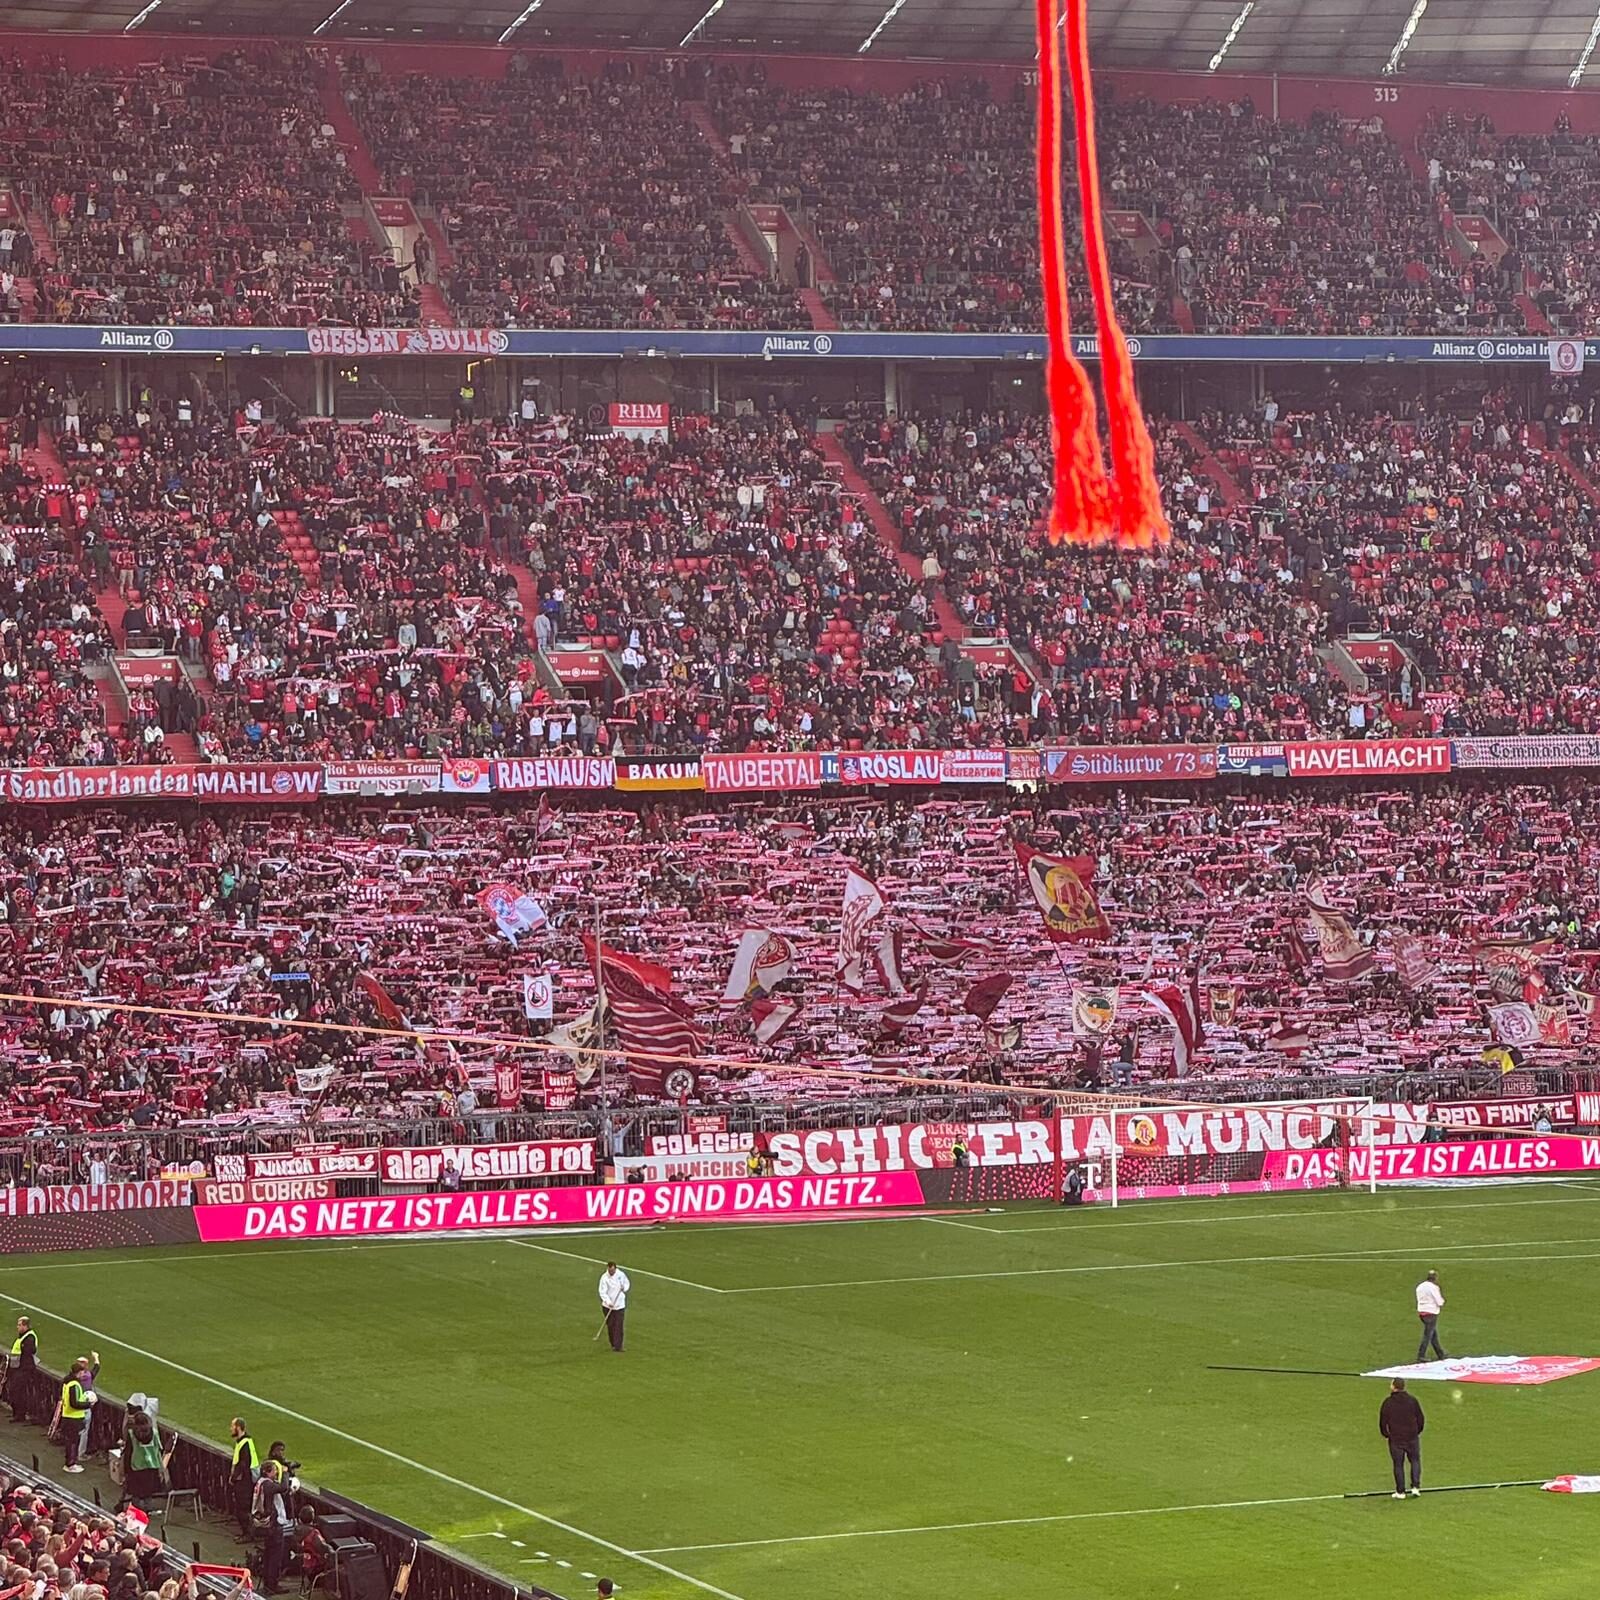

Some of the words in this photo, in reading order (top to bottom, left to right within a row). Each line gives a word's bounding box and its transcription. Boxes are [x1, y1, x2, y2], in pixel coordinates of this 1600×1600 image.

[1374, 87, 1399, 102] 313
[101, 332, 152, 346] Allianz
[307, 328, 399, 354] GIESSEN
[428, 329, 501, 355] BULLS
[763, 337, 811, 351] Allianz
[1432, 343, 1476, 356] Allianz
[1496, 343, 1536, 356] Global
[618, 403, 663, 419] RHM
[1227, 745, 1254, 757] LETZTE
[1262, 744, 1284, 756] REIHE
[1289, 745, 1448, 770] HAVELMACHT
[1489, 743, 1581, 758] Commando
[328, 763, 347, 776] Rot
[357, 763, 396, 776] Weisse
[498, 759, 613, 789] RABENAU/SN
[629, 762, 699, 780] BAKUM
[705, 758, 820, 789] TAUBERTAL
[861, 753, 940, 780] RÖSLAU
[1072, 753, 1164, 775] Südkurve
[1167, 752, 1196, 773] '73
[10, 769, 189, 800] Sandharlanden
[214, 1154, 245, 1166] SEEN
[215, 1165, 247, 1175] LAND
[551, 1142, 594, 1175] rot
[1285, 1151, 1340, 1181] DAS
[1422, 1146, 1464, 1173] IST
[1469, 1142, 1557, 1170] ALLES.
[215, 1174, 247, 1183] FRONT
[50, 1180, 191, 1214] ROHRDORF
[205, 1182, 246, 1204] RED
[252, 1180, 328, 1202] COBRAS
[586, 1188, 646, 1217] WIR
[653, 1183, 726, 1214] SIND
[733, 1181, 793, 1210] DAS
[801, 1176, 883, 1207] NETZ.
[244, 1204, 308, 1236] DAS
[316, 1200, 397, 1232] NETZ
[404, 1198, 453, 1227] IST
[456, 1192, 558, 1224] ALLES.
